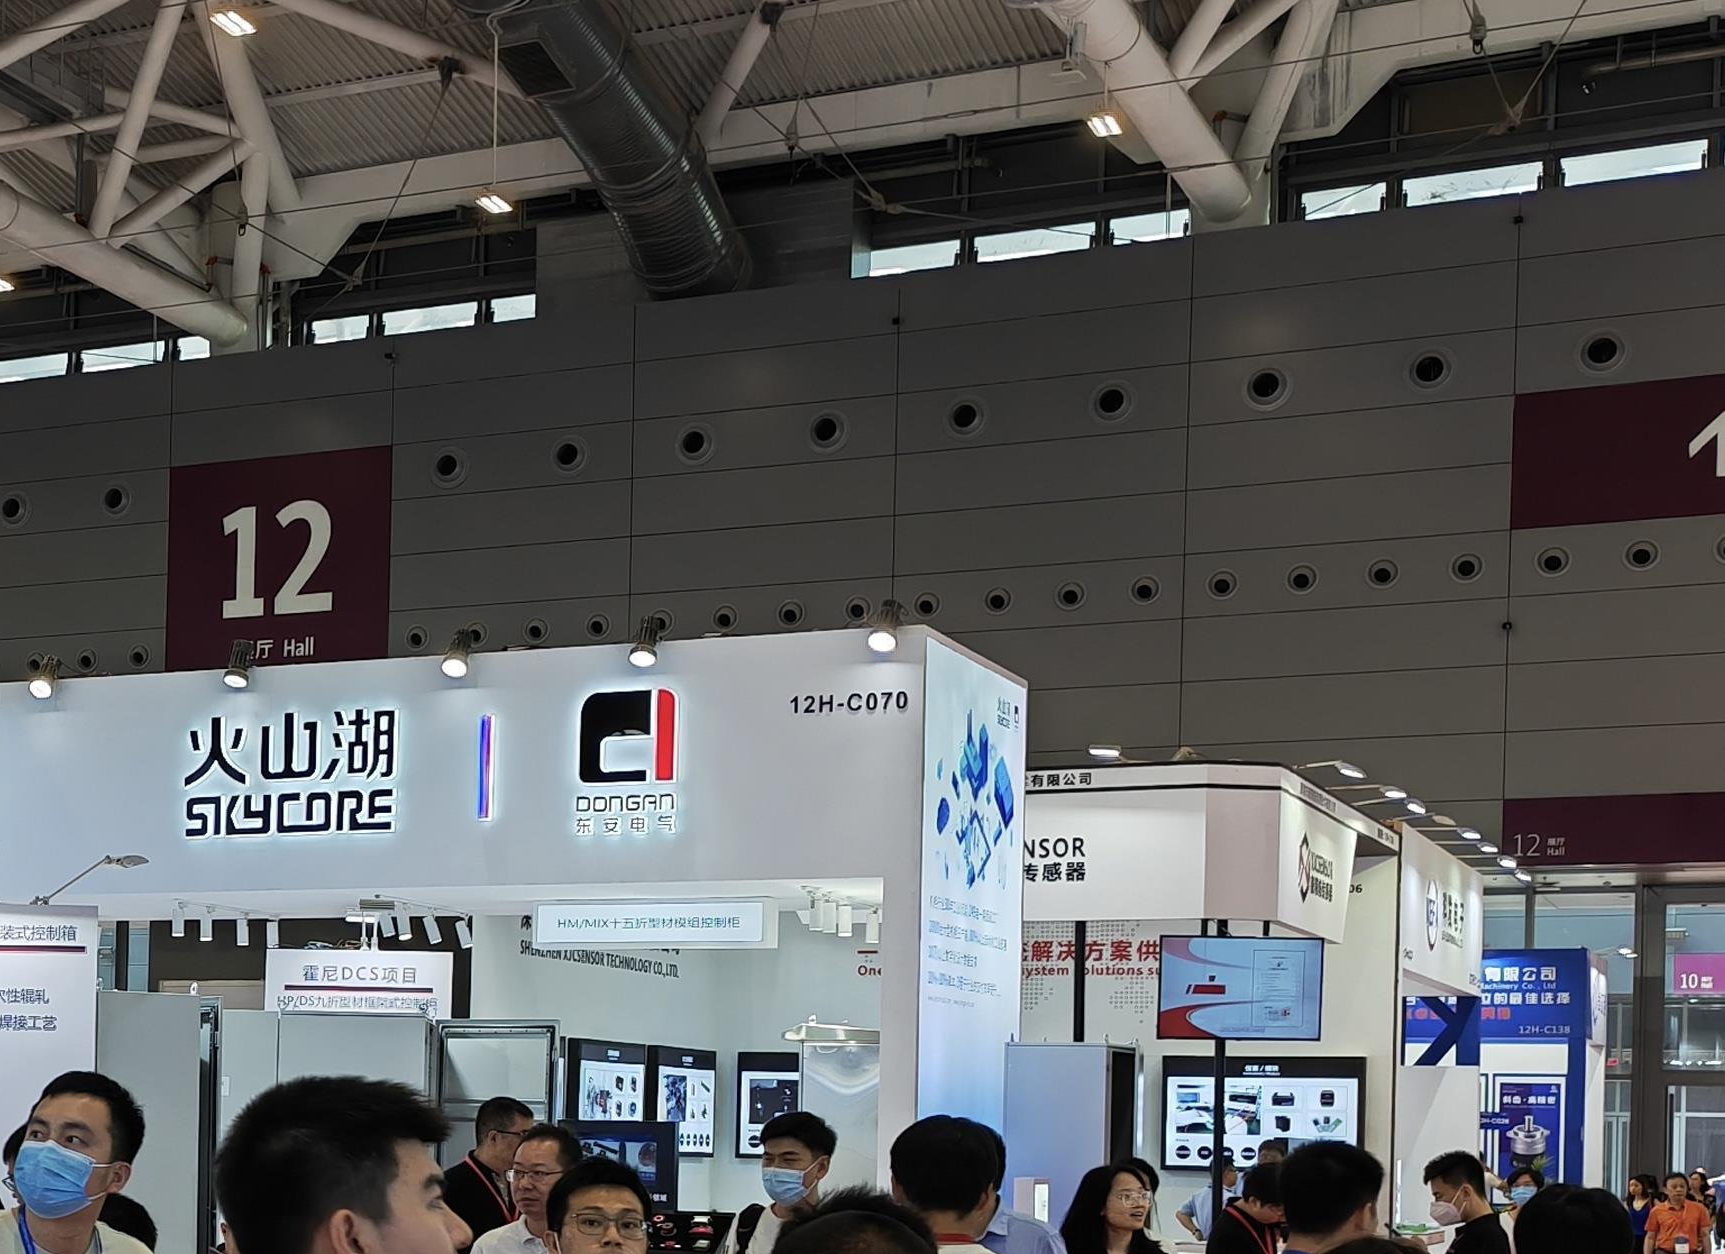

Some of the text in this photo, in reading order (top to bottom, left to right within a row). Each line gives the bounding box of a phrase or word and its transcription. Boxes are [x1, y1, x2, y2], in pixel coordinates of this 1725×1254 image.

[222, 499, 333, 620] 12
[249, 636, 315, 660] 厅 Hall
[789, 690, 909, 715] 12H-C070
[183, 707, 399, 788] 火山湖
[1026, 772, 1092, 787] 有限公司
[184, 788, 396, 838] SKYCORE
[575, 793, 676, 814] DONGAN
[574, 815, 675, 836] 东安电气
[1514, 834, 1541, 857] 12
[1547, 847, 1565, 856] Hall
[605, 952, 653, 974] TECHNOLOGY
[302, 964, 417, 985] 霍尼DCS项目
[1485, 966, 1556, 982] 有限公司
[1680, 973, 1698, 989] 10
[1543, 982, 1556, 990] Ltd
[1518, 1025, 1571, 1034] 12H-C138
